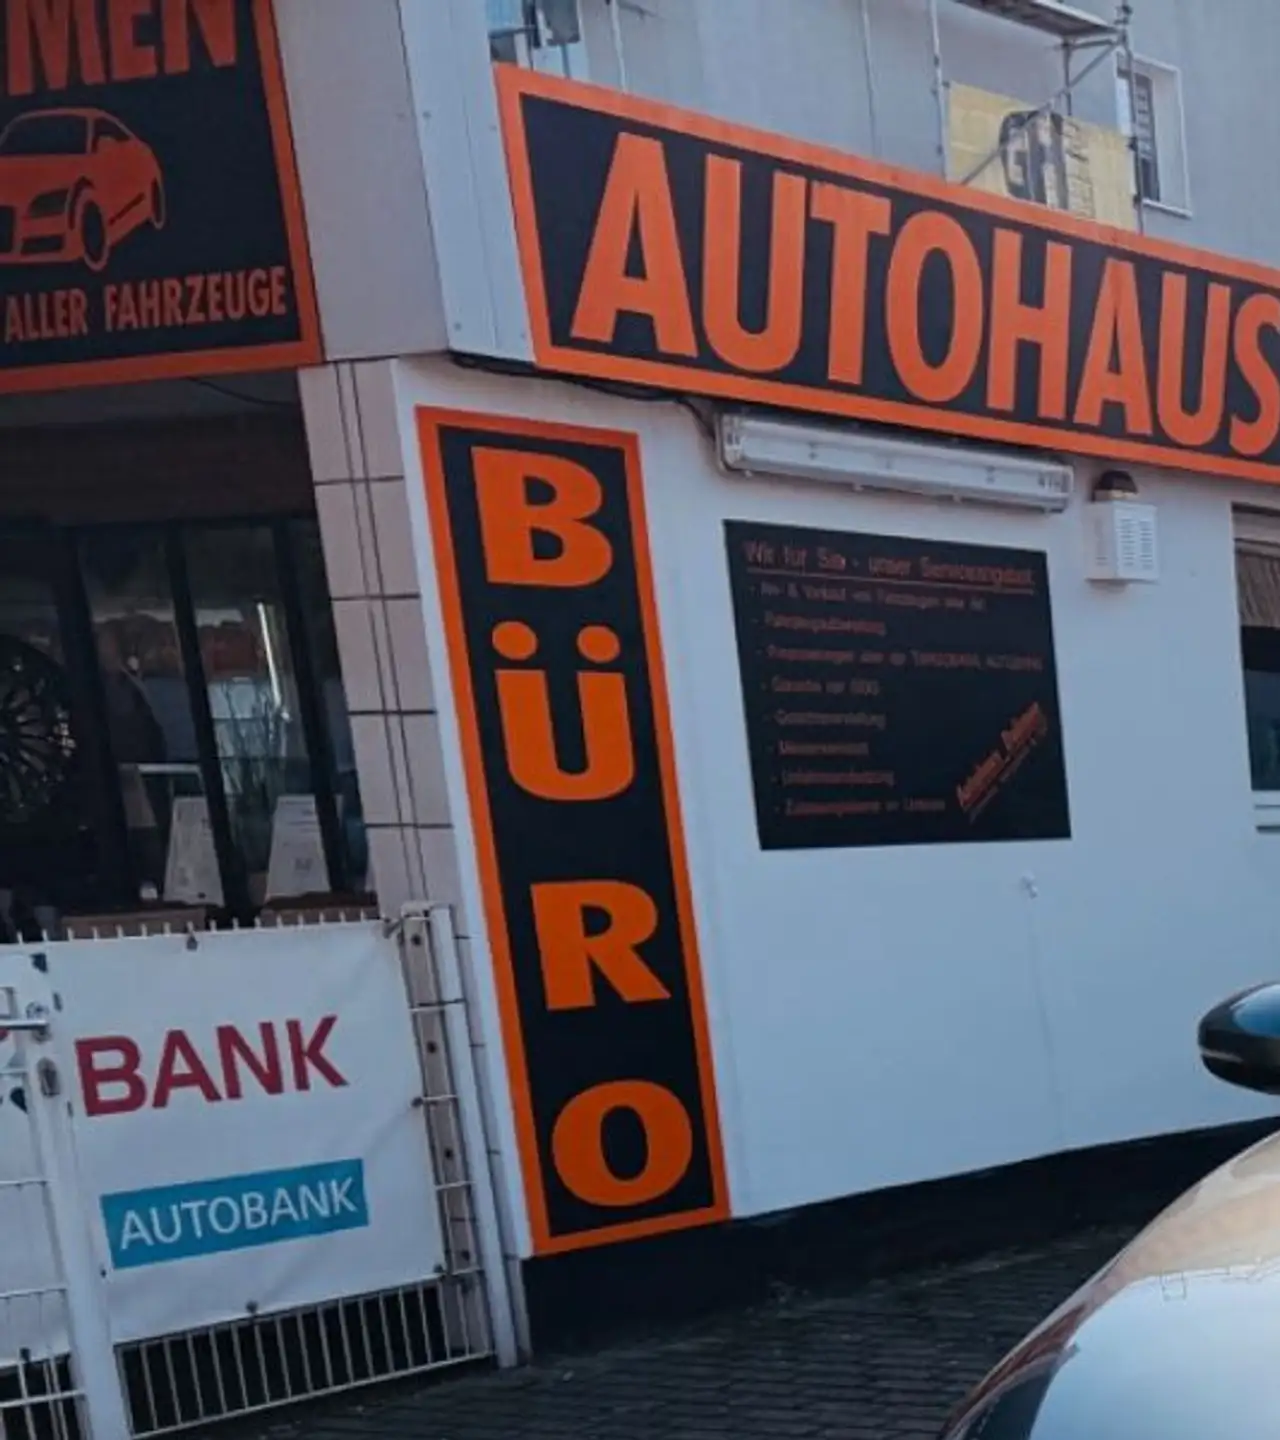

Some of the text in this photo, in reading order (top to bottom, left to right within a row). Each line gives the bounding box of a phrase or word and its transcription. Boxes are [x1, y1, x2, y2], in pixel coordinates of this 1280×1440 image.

[5, 266, 287, 343] ALLER FAHRZEUGE
[74, 1014, 349, 1118] BANK
[118, 1175, 359, 1251] AUTOBANK
